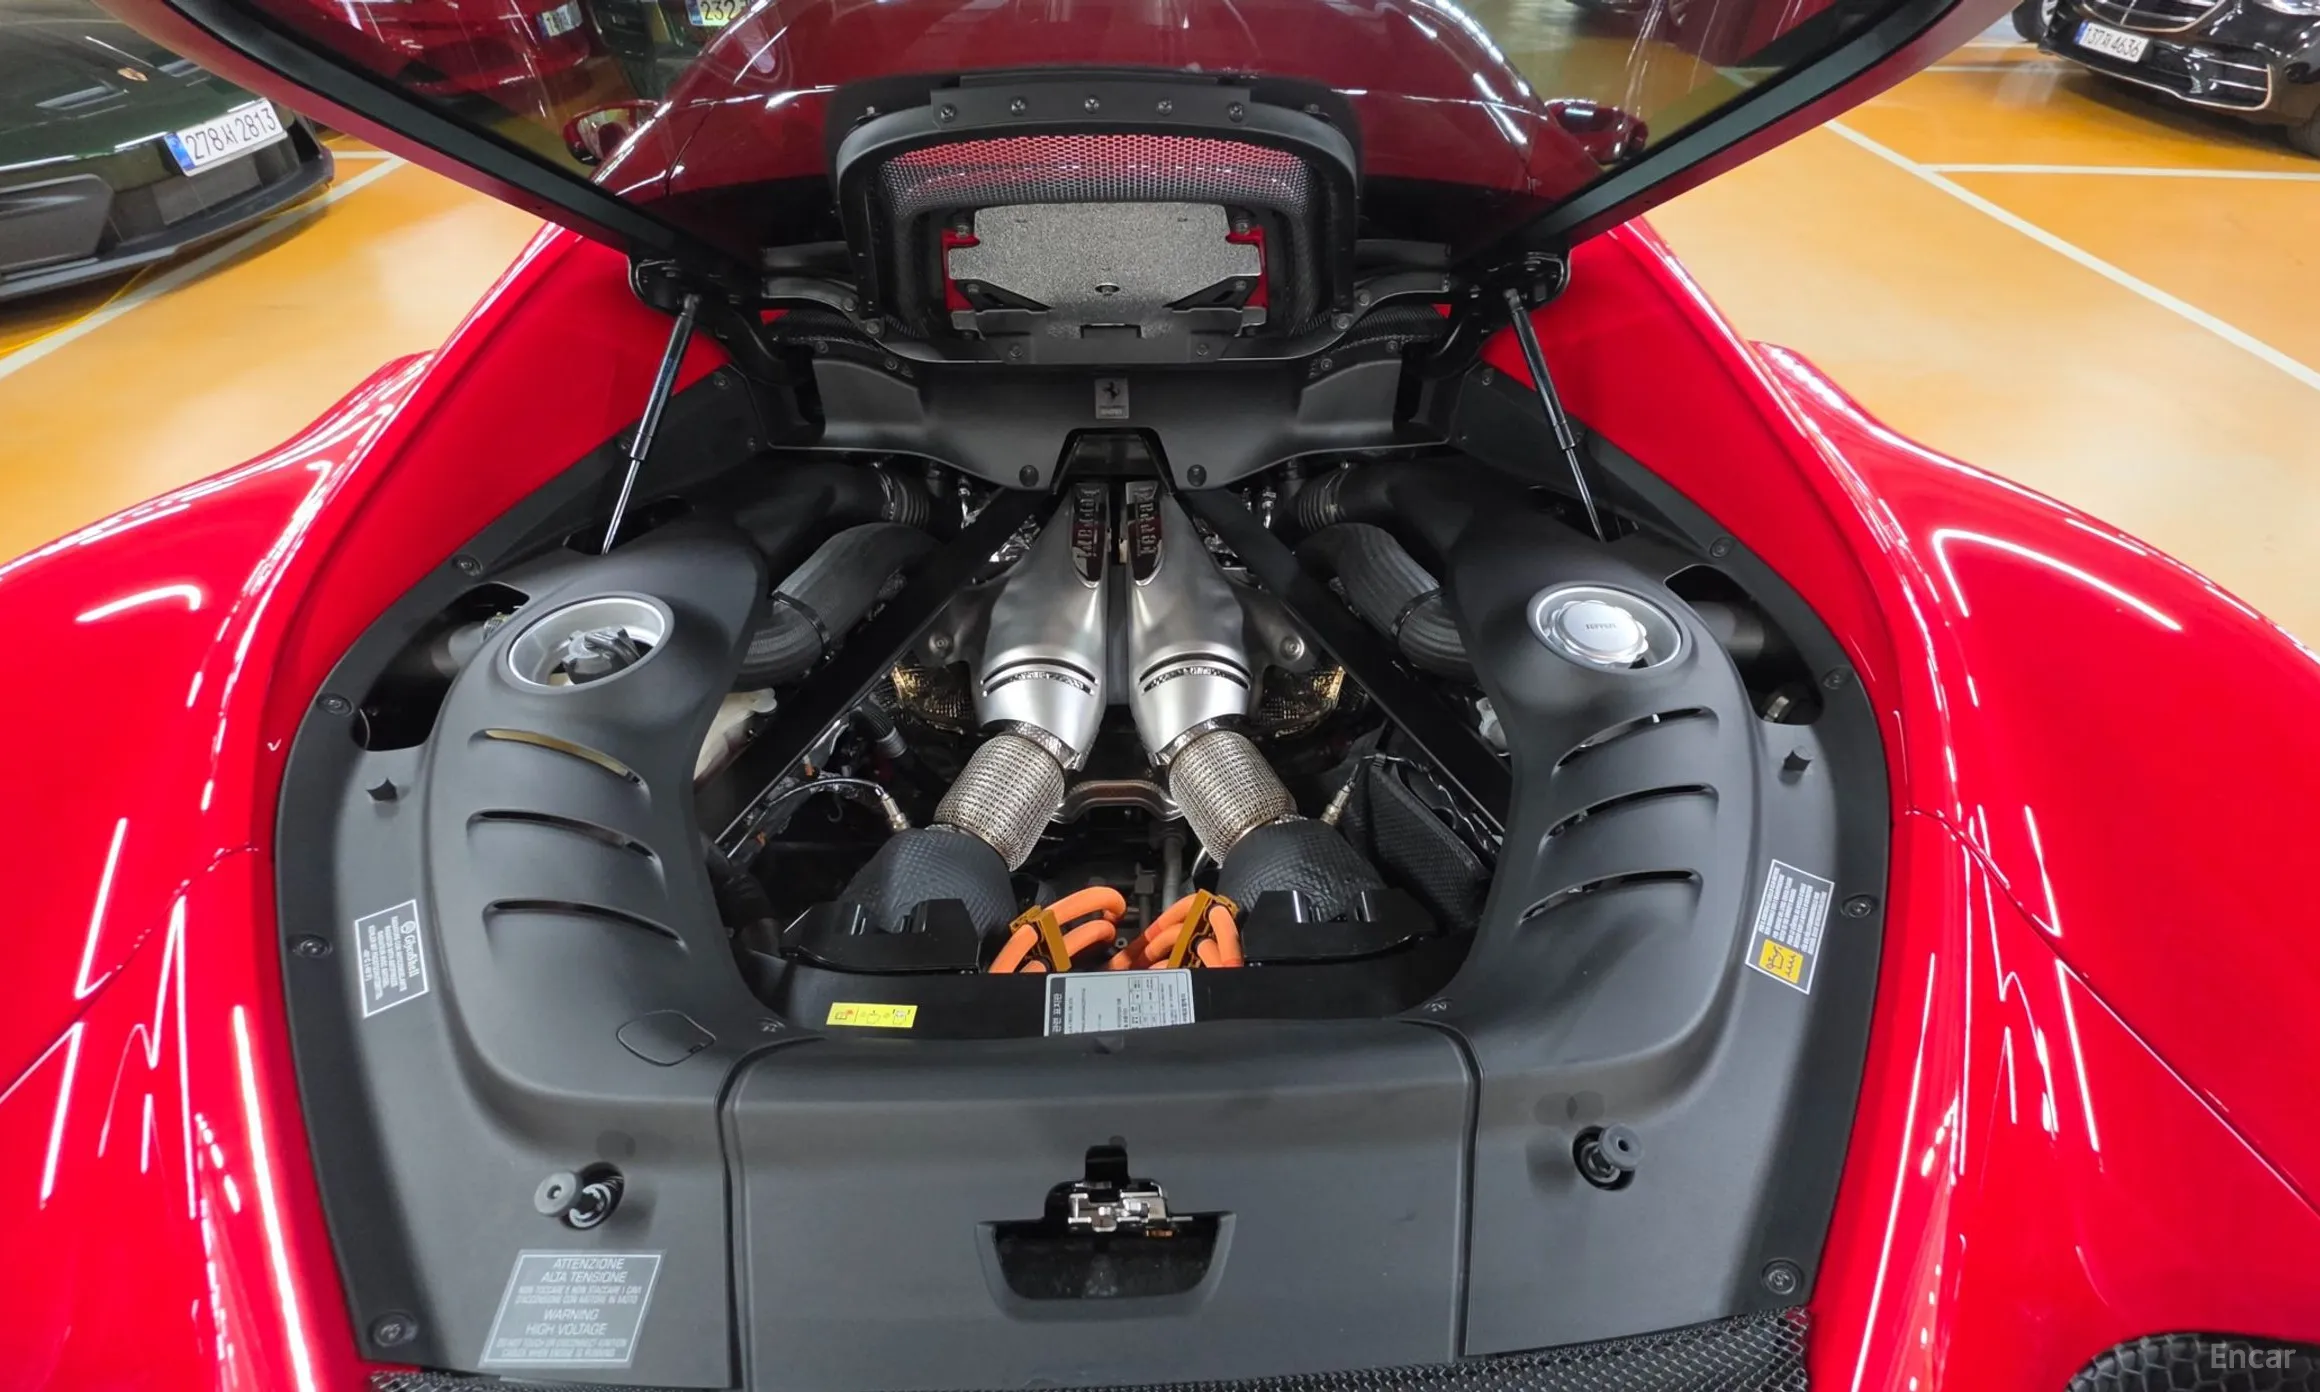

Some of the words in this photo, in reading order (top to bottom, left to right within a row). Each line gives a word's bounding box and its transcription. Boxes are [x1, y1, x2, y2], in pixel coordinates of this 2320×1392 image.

[701, 0, 749, 20] 232
[185, 107, 276, 160] 278서2813
[553, 1258, 625, 1270] ATTENZIONE
[540, 1271, 567, 1283] ALTA
[570, 1271, 628, 1283] TENSIONE
[544, 1309, 600, 1321] WARNING
[526, 1323, 555, 1335] HIGH
[558, 1323, 608, 1335] VOLTAGE
